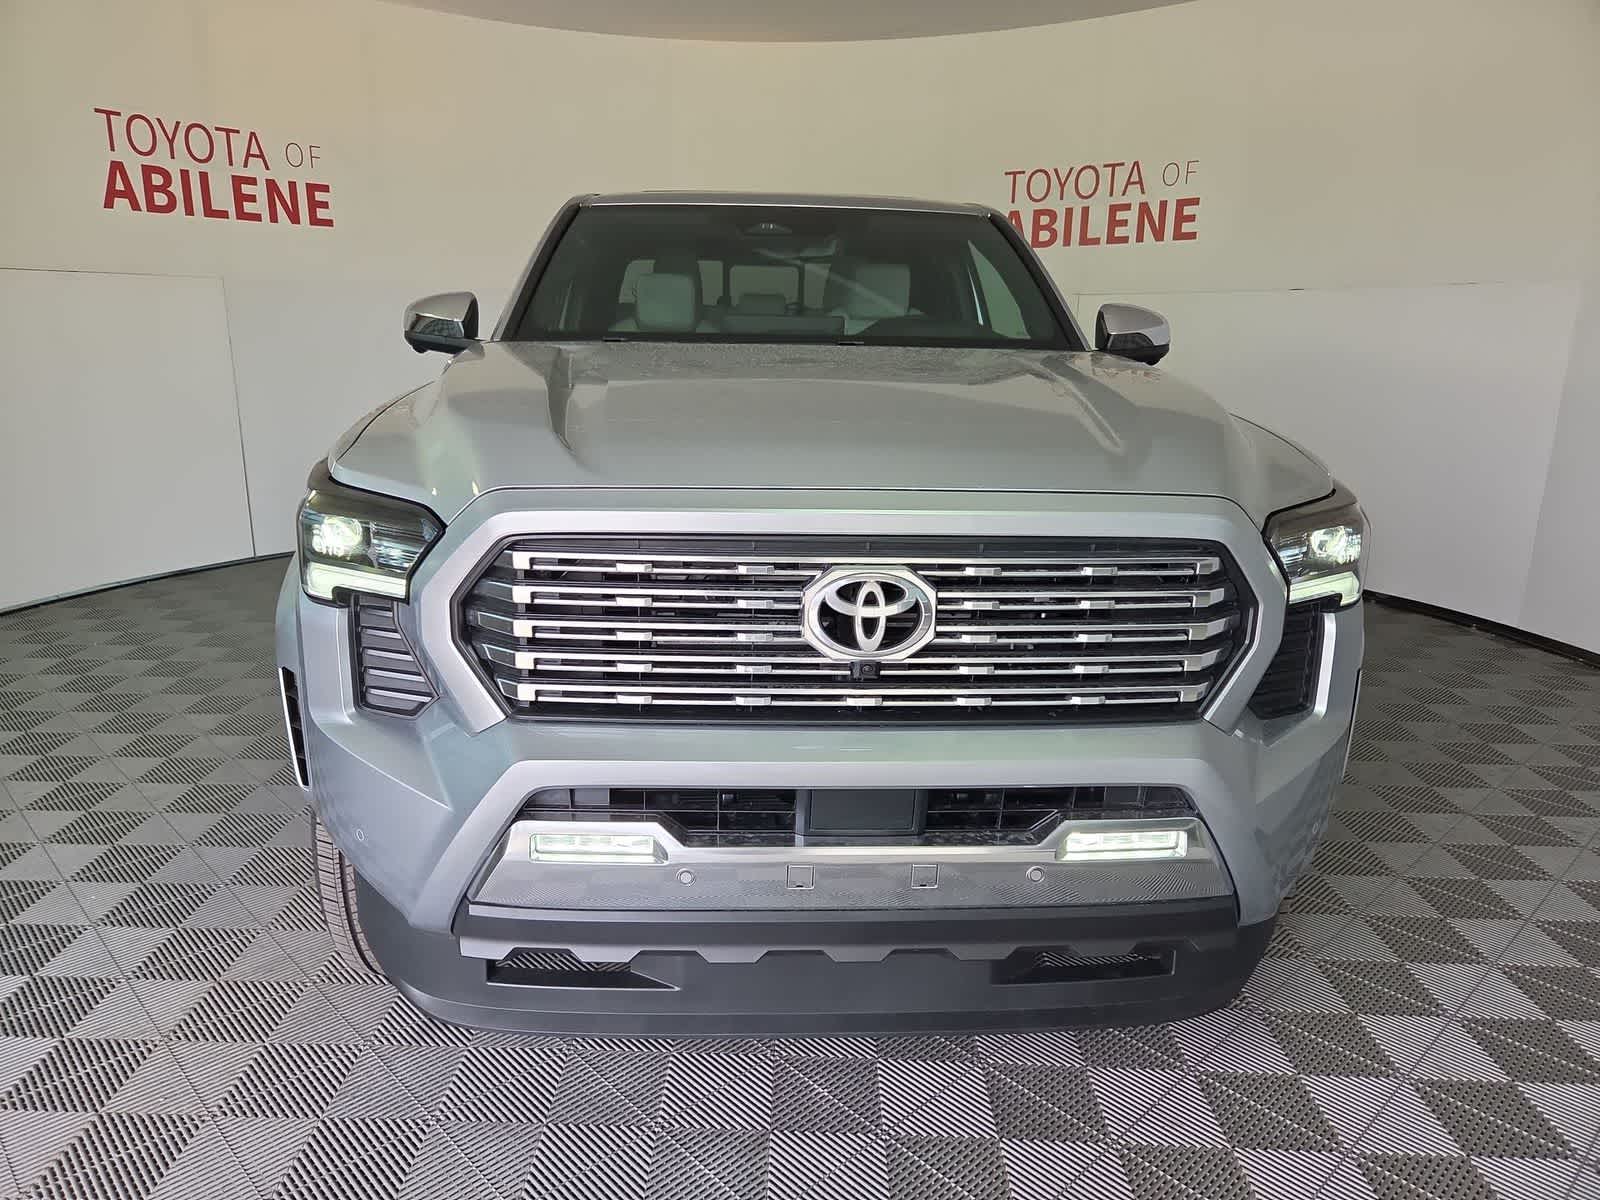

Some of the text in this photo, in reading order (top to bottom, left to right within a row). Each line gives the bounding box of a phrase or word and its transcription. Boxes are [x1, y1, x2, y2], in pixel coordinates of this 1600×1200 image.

[94, 107, 321, 171] TOYOTA OF
[103, 159, 334, 228] ABILENE
[1004, 160, 1200, 204] TOYOTA OF
